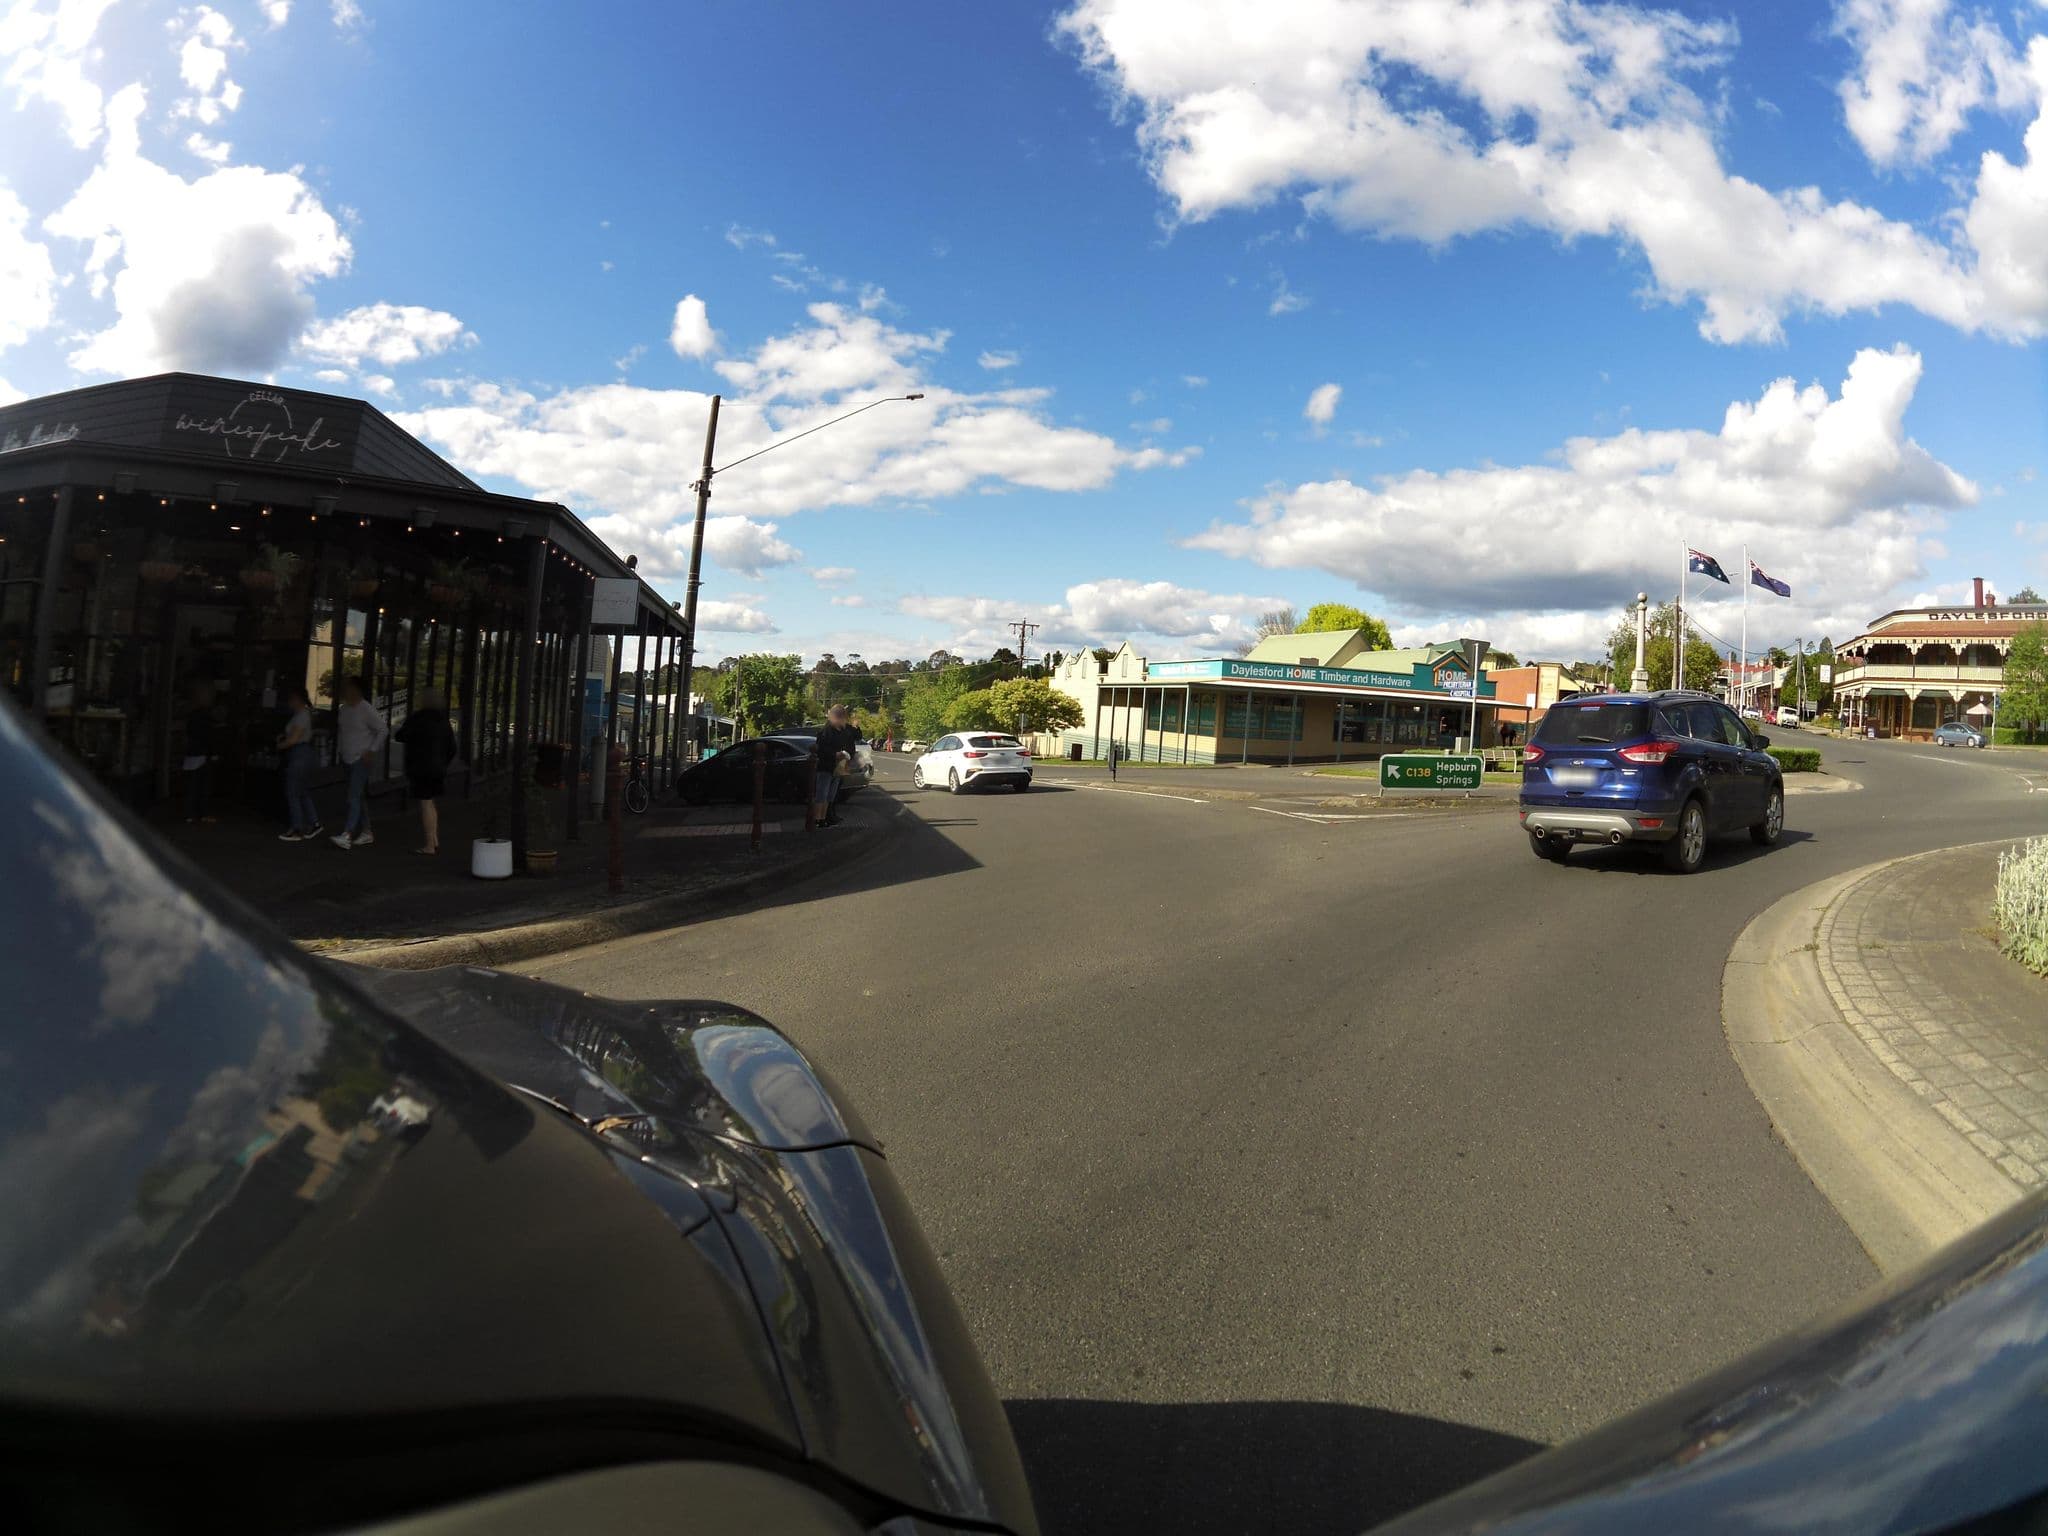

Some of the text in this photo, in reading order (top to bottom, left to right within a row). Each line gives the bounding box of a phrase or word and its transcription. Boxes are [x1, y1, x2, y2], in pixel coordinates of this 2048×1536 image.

[1929, 612, 2048, 621] DAYLESFORD
[1231, 663, 1412, 687] Daylesford HOME Timber and Hardware
[1438, 670, 1467, 681] HOME
[1406, 767, 1432, 777] C138
[1436, 762, 1477, 773] Hepburn
[1436, 775, 1473, 787] Springs
